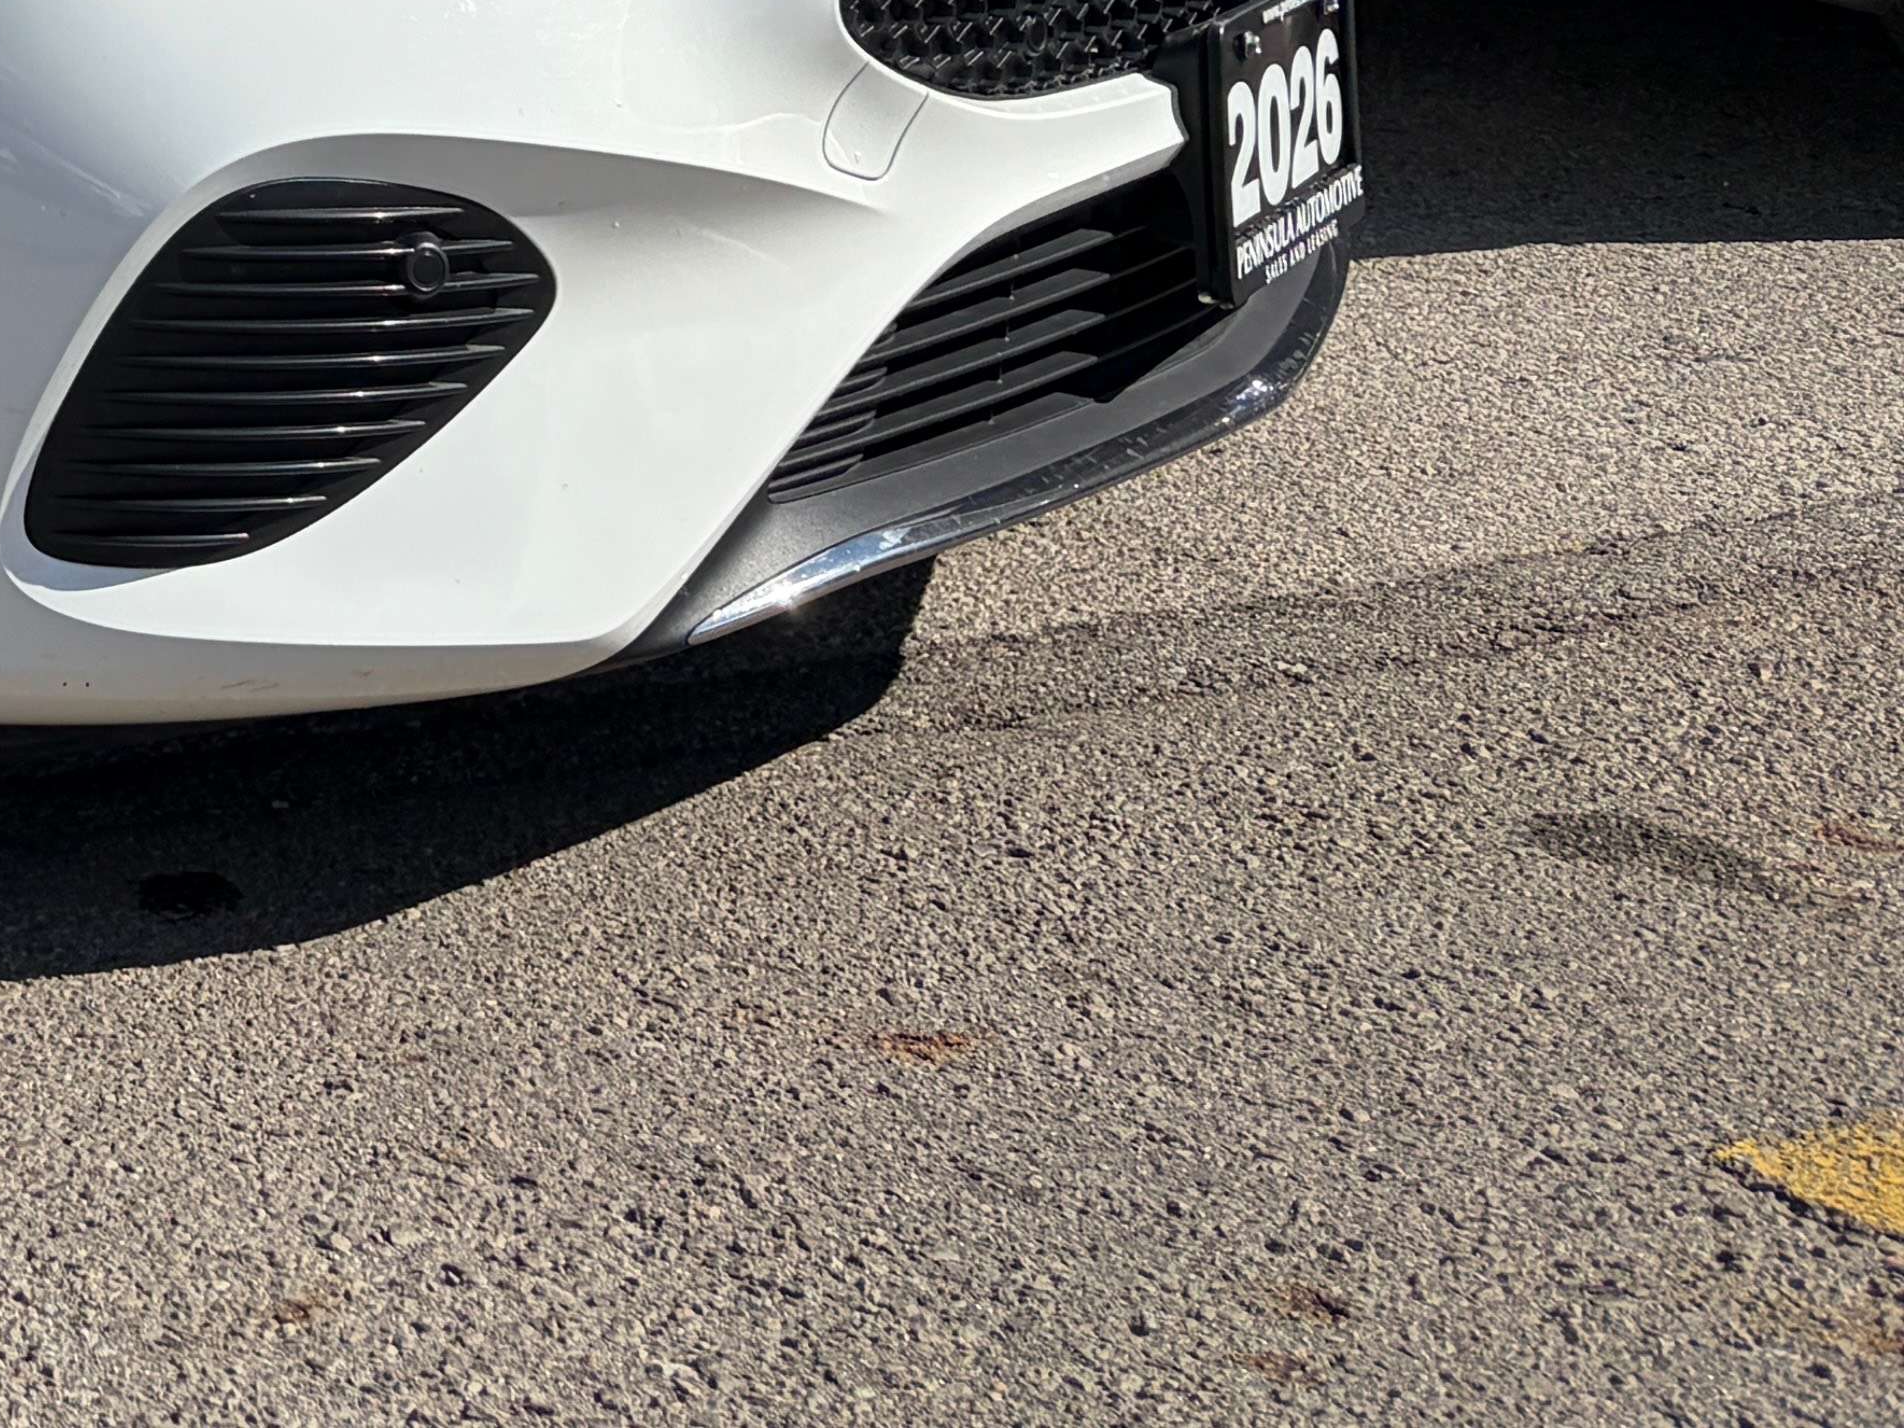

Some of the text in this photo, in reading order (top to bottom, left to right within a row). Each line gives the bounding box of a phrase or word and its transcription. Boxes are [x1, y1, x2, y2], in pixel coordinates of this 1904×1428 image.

[1226, 28, 1343, 228] 2026
[1235, 164, 1364, 280] PENINSULA AUTOMOTIVE
